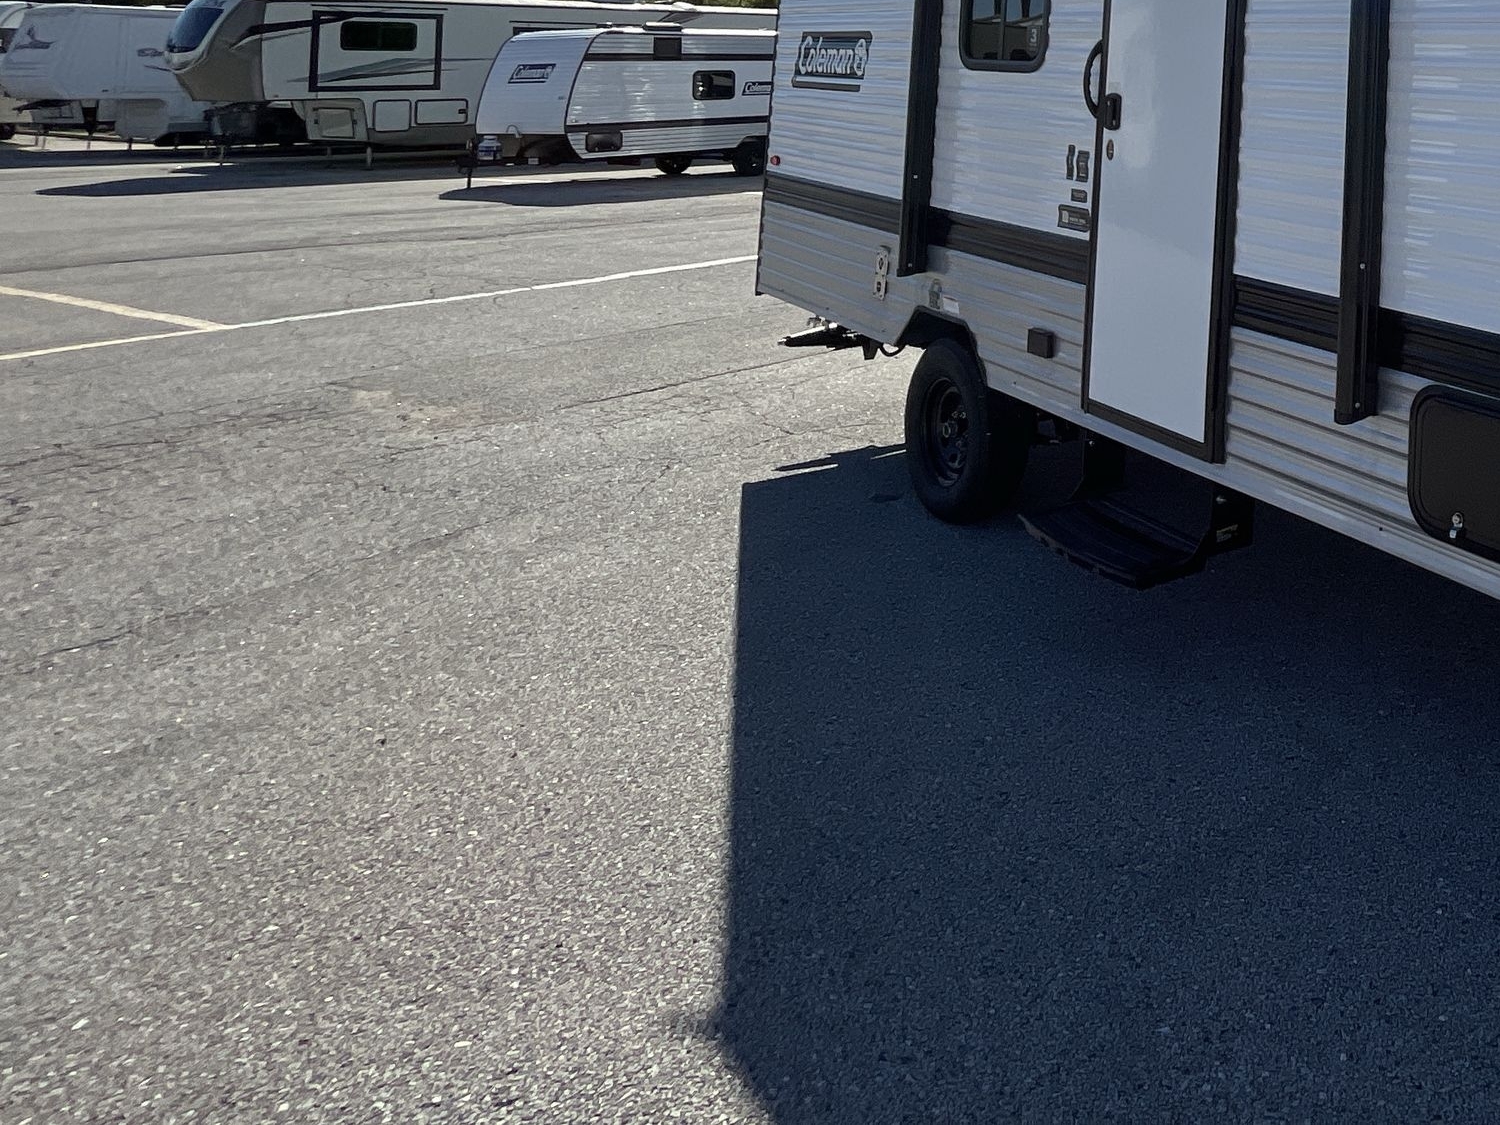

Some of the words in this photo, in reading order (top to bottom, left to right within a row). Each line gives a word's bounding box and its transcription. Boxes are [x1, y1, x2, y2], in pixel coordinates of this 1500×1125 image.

[1030, 28, 1037, 43] 3
[801, 36, 853, 75] Coleman
[745, 82, 771, 93] Colem
